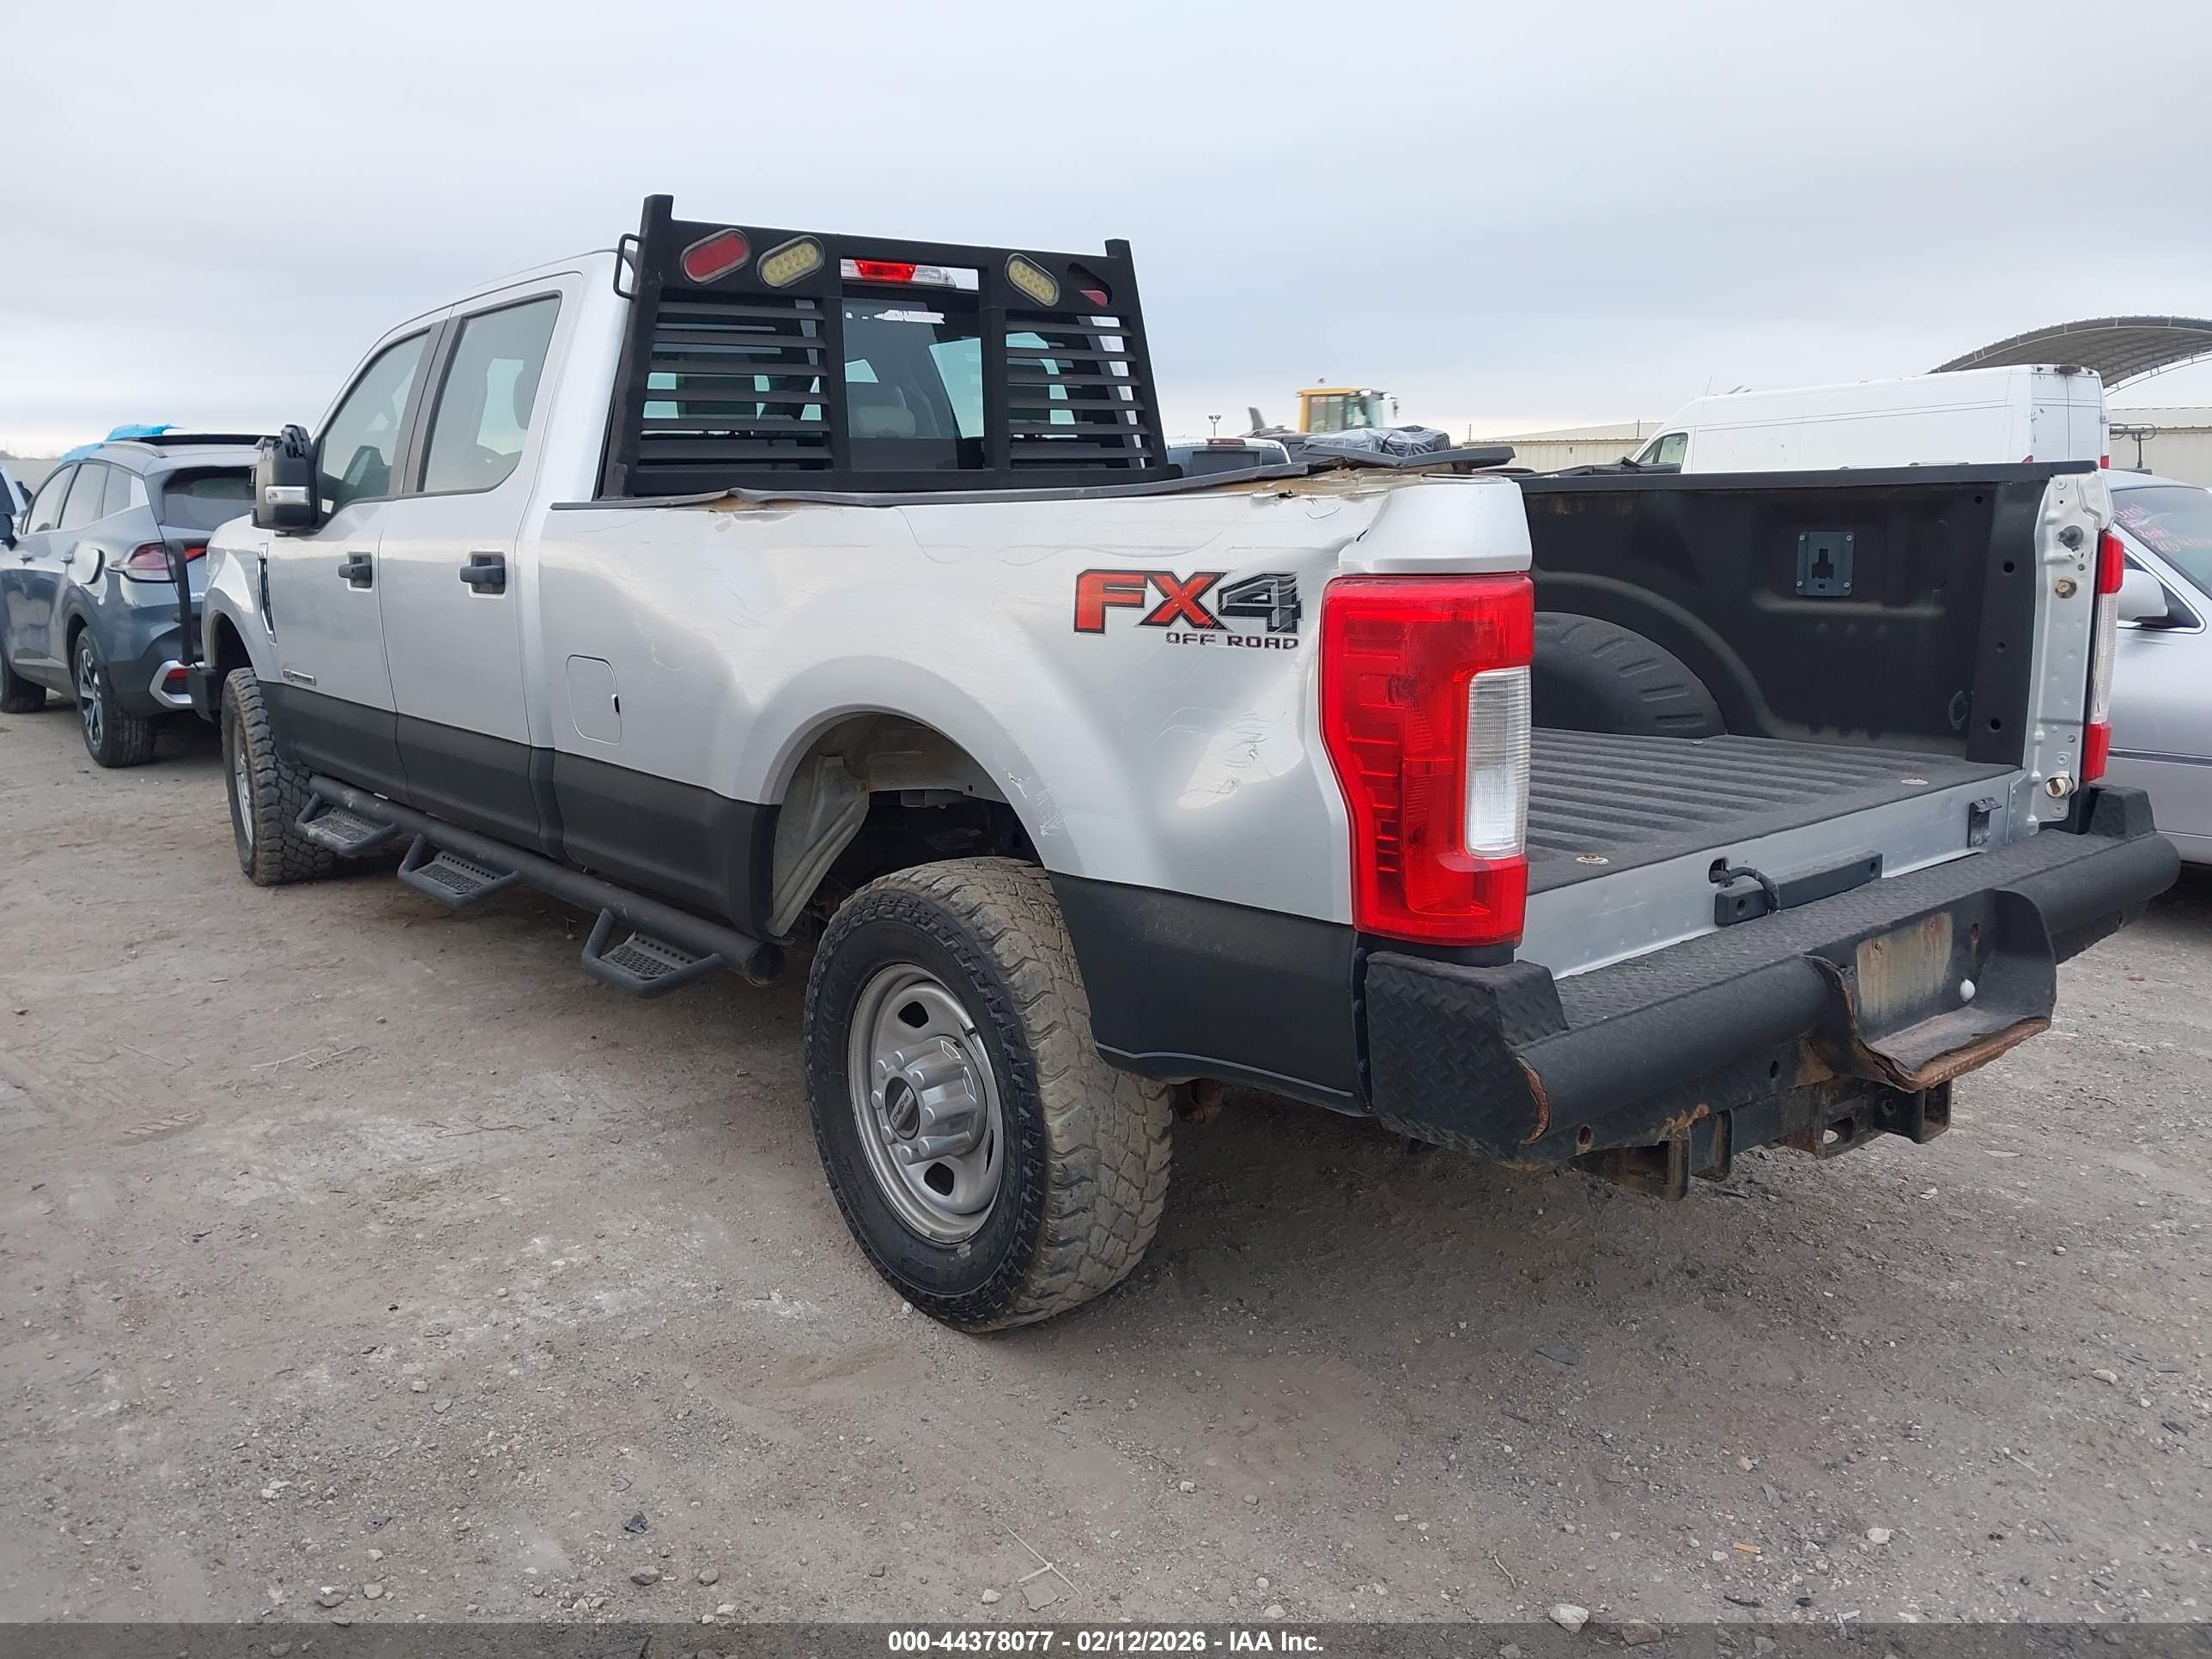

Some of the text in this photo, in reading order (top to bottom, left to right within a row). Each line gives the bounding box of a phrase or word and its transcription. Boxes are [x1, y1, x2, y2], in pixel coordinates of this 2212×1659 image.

[1073, 568, 1304, 635] FX4
[1165, 631, 1300, 651] OFF ROAD
